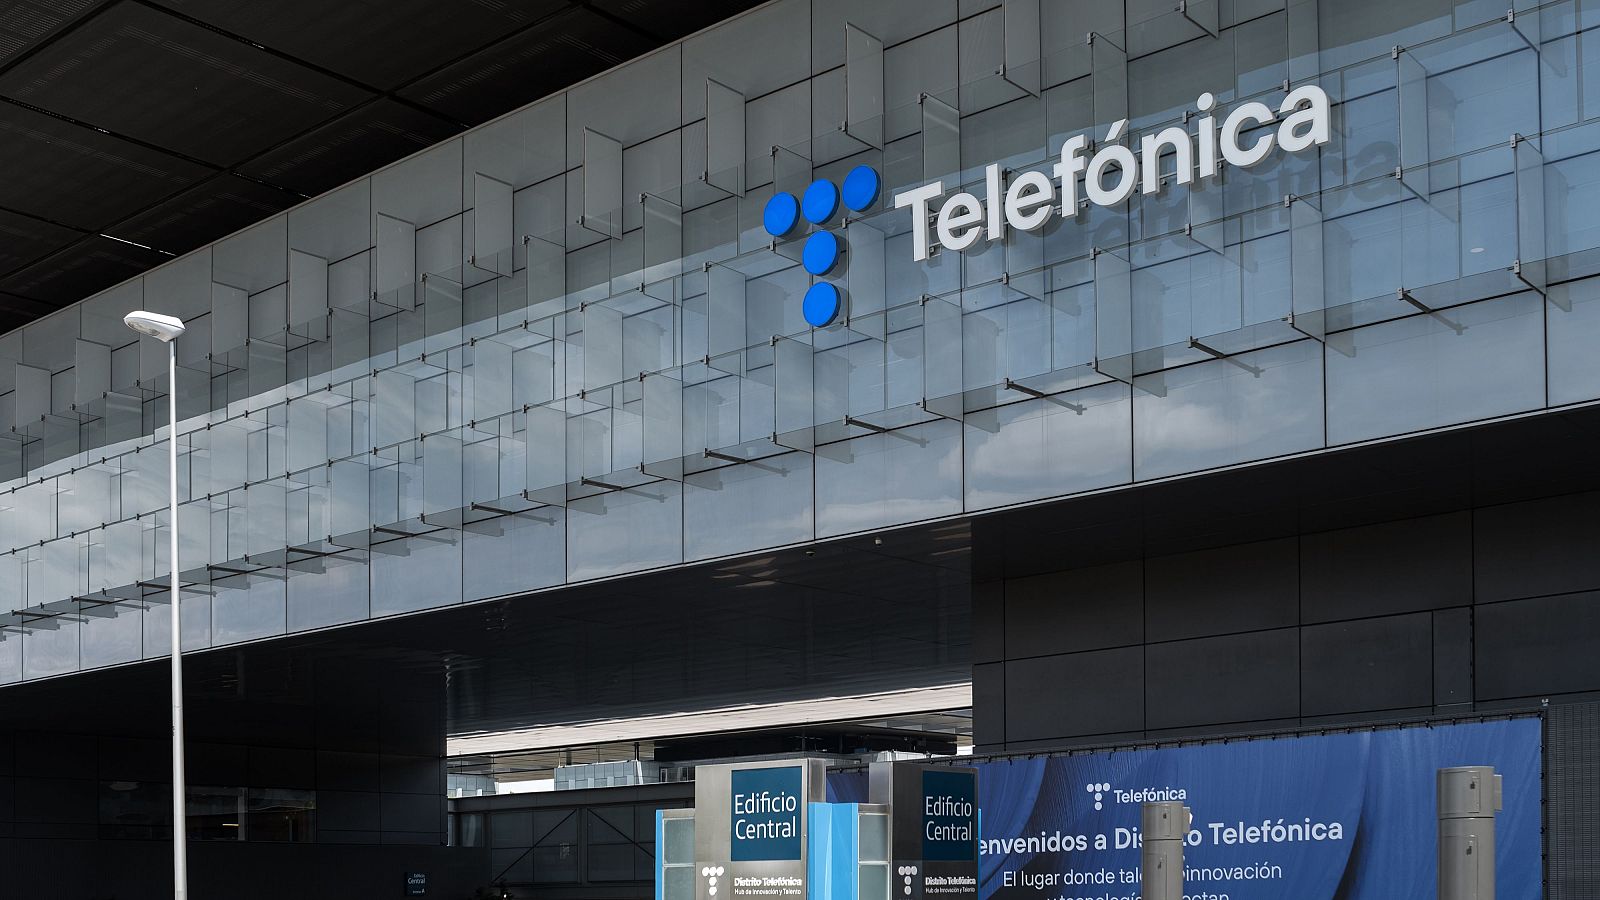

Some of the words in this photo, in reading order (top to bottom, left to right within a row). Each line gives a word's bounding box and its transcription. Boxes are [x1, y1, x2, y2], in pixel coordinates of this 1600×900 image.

[895, 85, 1331, 262] Telefónica
[735, 791, 797, 815] Edificio
[925, 795, 972, 817] Edificio
[1113, 786, 1187, 804] Telefónica
[735, 816, 796, 840] Central
[926, 820, 972, 841] Central
[980, 830, 1088, 855] envenidos
[1094, 833, 1107, 851] a
[1208, 817, 1343, 845] Telefónica
[734, 876, 762, 887] Distrito
[762, 876, 803, 887] Telefónica
[925, 876, 947, 886] Distrito
[947, 876, 977, 886] Telefónica
[1003, 870, 1017, 887] El
[1021, 870, 1061, 890] lugar
[1064, 867, 1116, 885] donde
